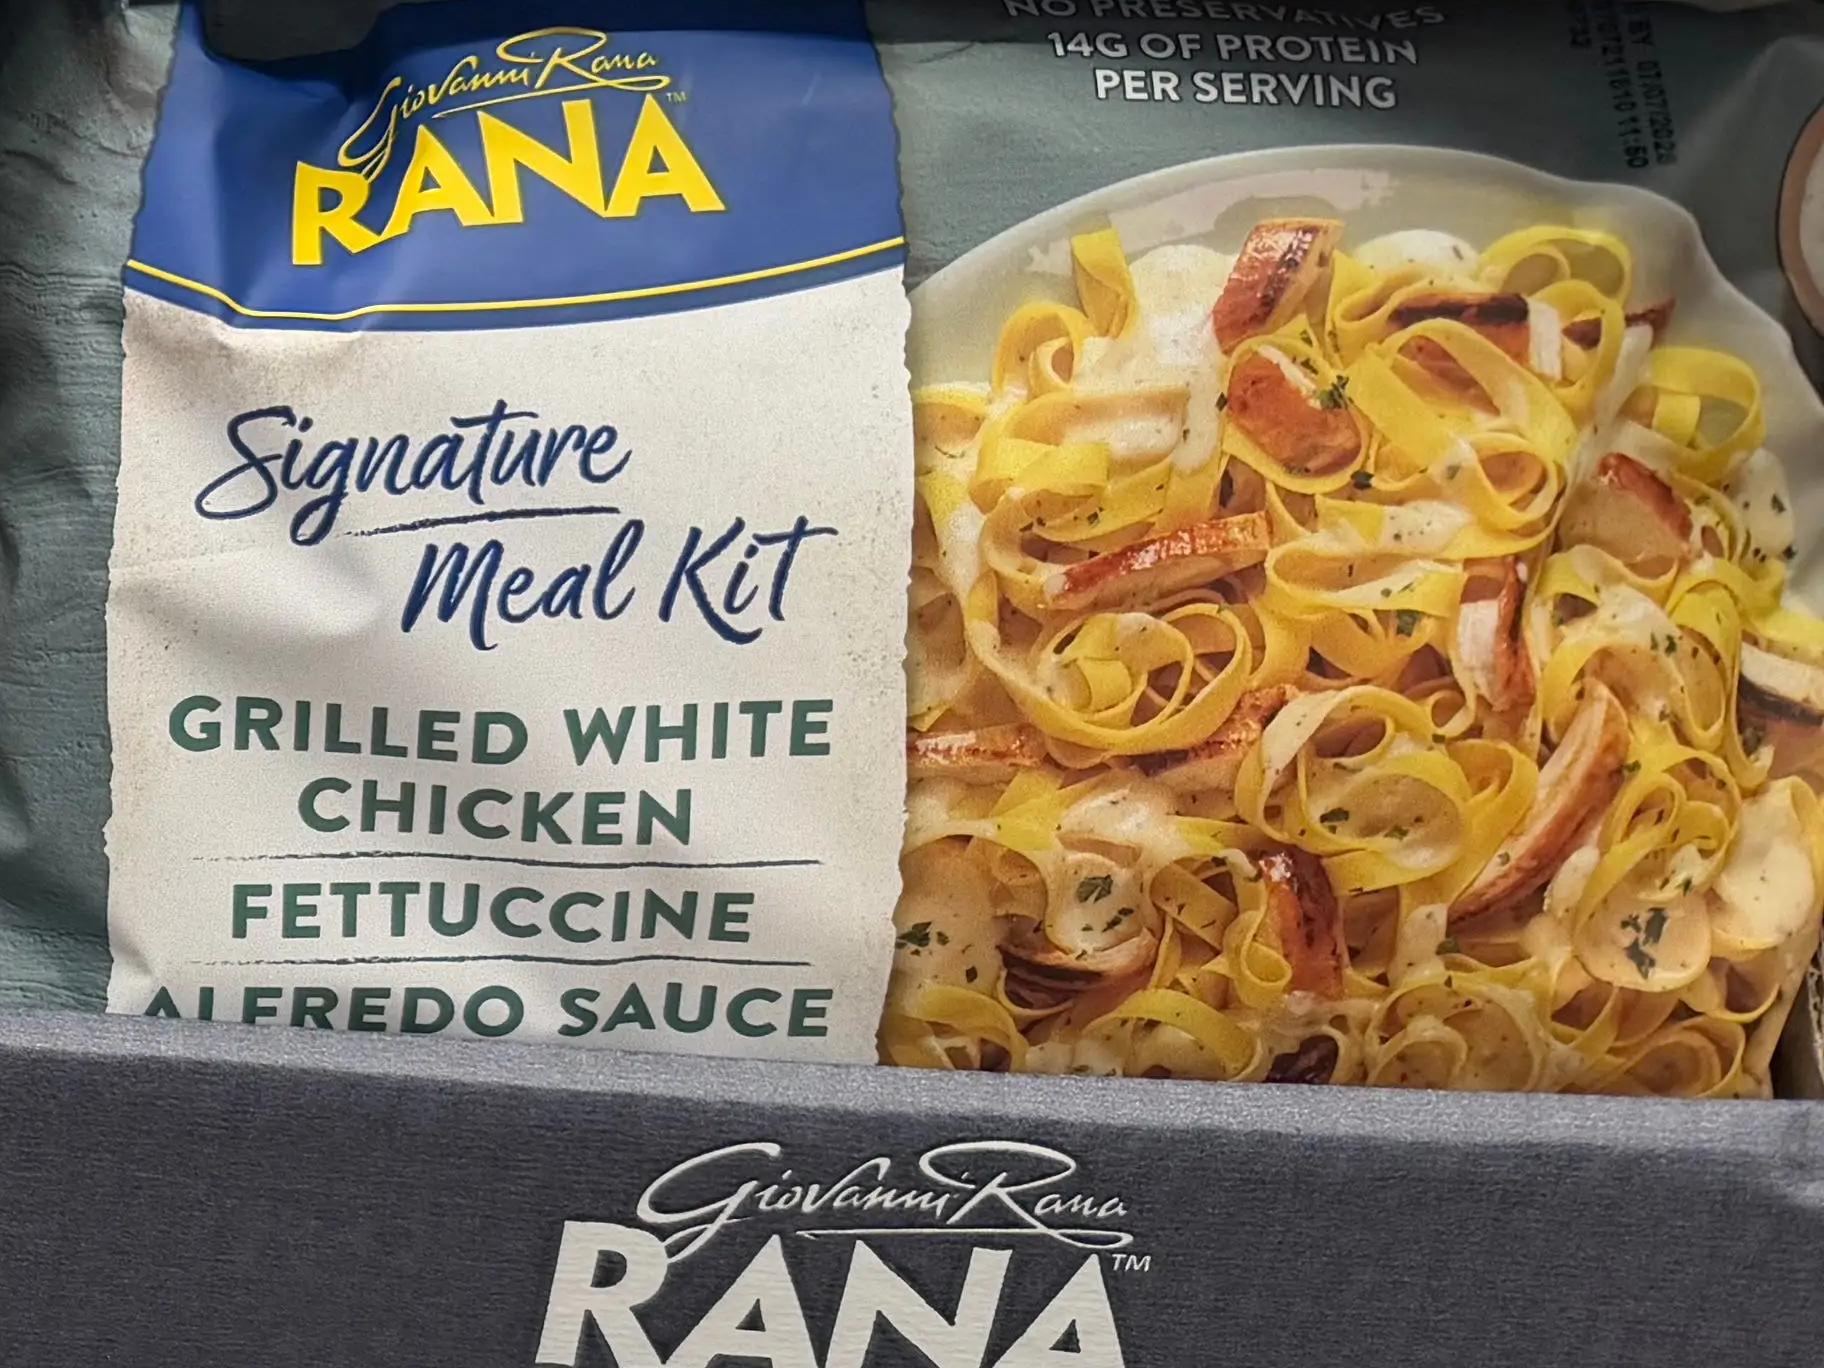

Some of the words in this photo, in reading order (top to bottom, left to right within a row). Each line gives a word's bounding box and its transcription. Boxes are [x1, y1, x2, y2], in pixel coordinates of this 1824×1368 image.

[1048, 32, 1128, 61] 14G
[1139, 33, 1207, 62] OF
[1218, 33, 1420, 66] PROTEIN
[1094, 69, 1181, 103] PER
[1193, 70, 1398, 110] SERVING
[291, 92, 726, 267] RANA
[194, 399, 633, 547] Signature
[401, 520, 645, 652] Meal
[658, 516, 839, 645] Kit
[168, 694, 529, 765] GRILLED
[563, 698, 834, 765] WHITE
[298, 777, 693, 847] CHICKEN
[231, 882, 756, 945] FETTUCCINE
[558, 984, 834, 1037] SAUCE
